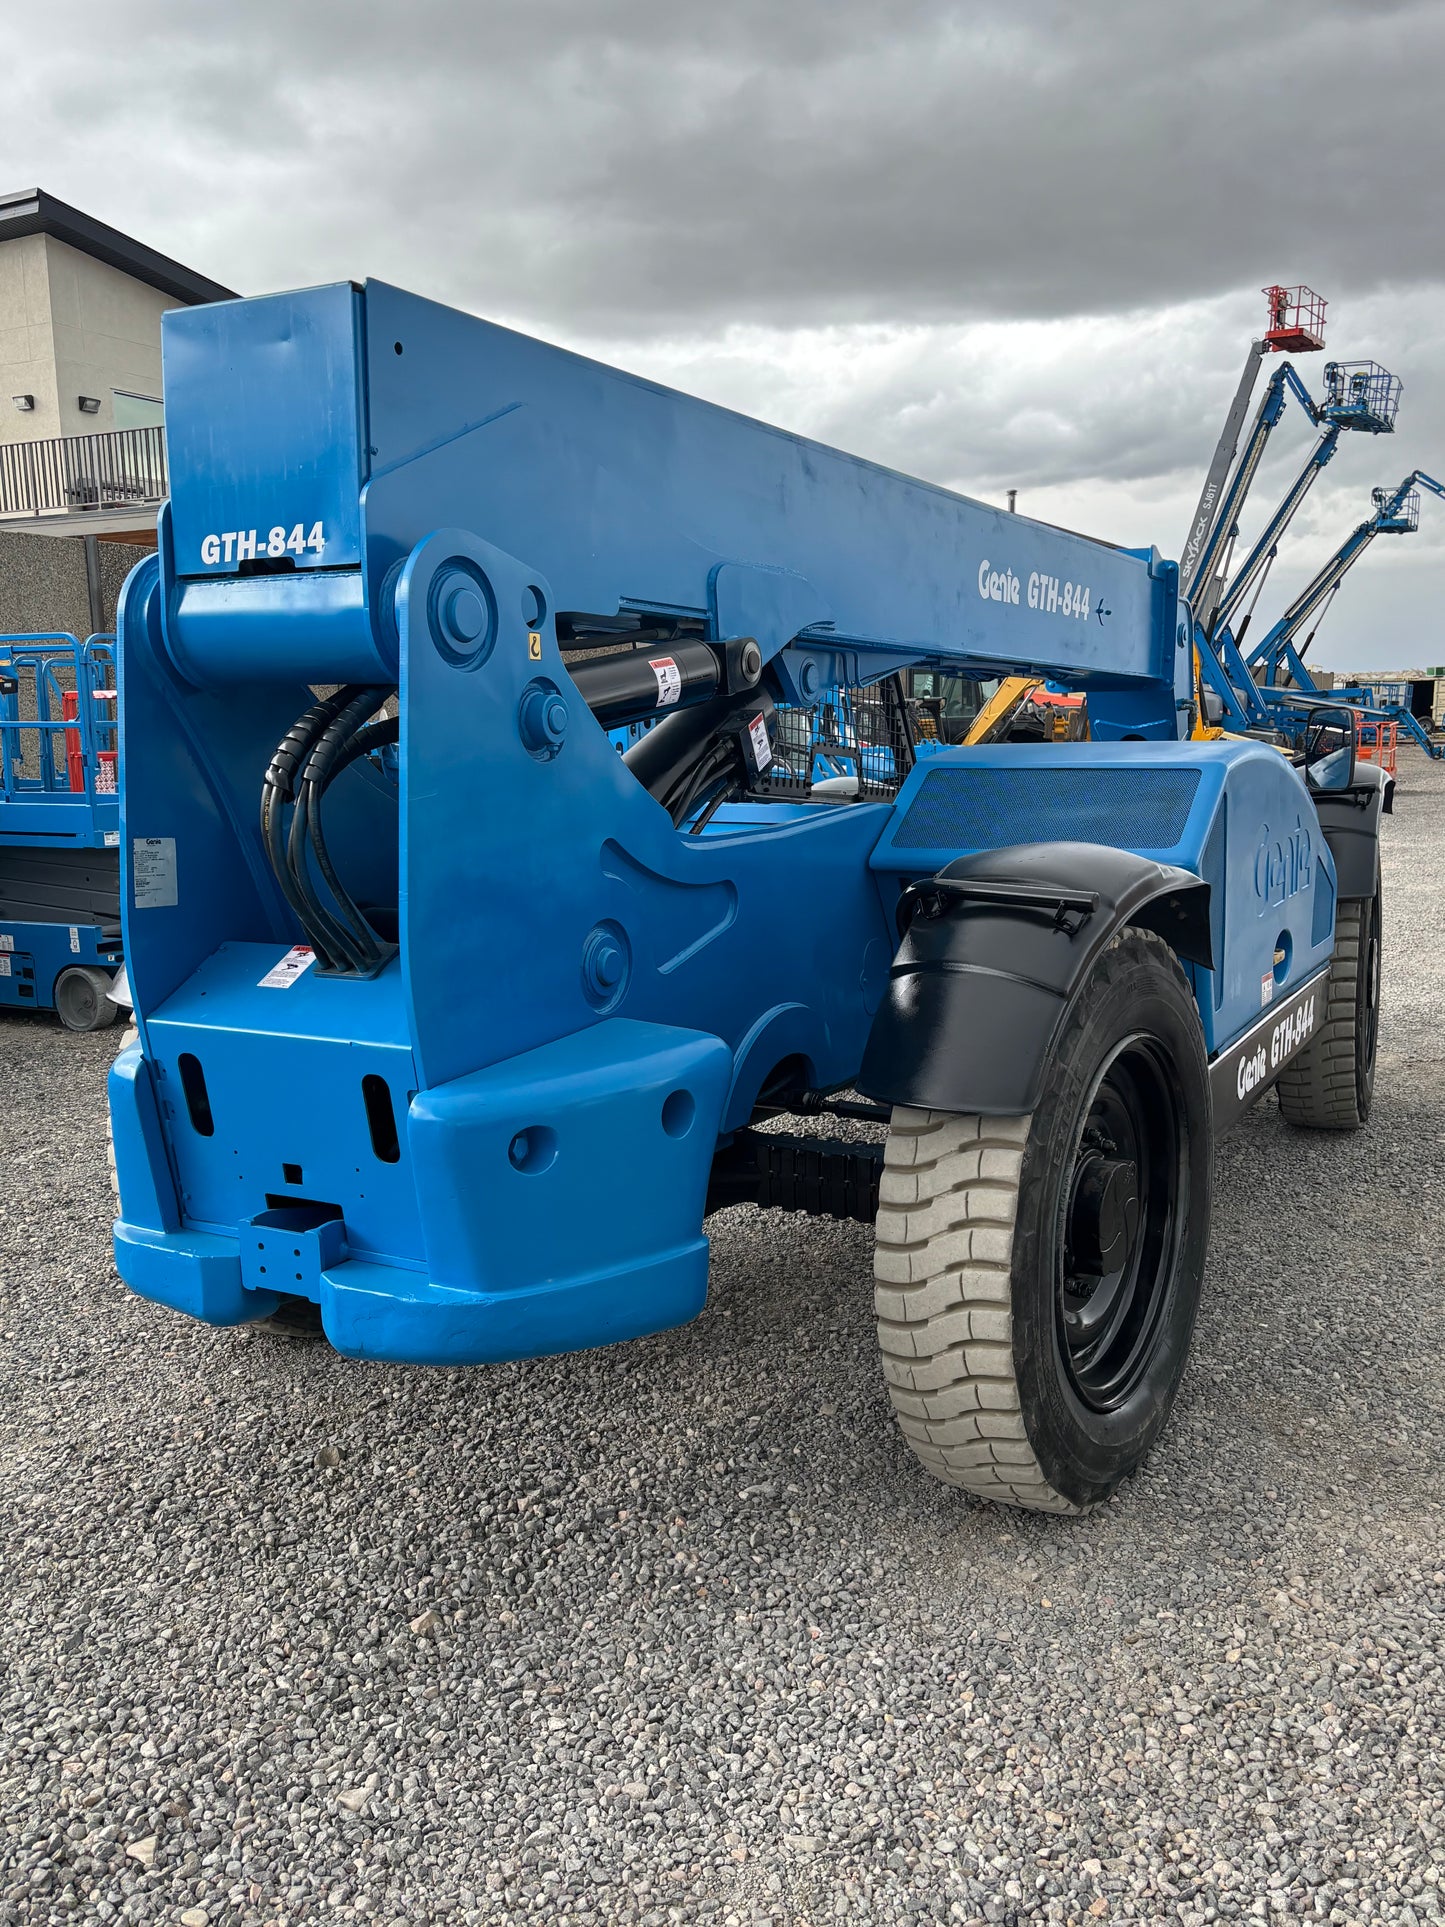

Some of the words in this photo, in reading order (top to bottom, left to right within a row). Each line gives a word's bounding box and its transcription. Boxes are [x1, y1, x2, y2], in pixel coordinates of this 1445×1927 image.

[201, 521, 325, 565] GTH-844
[1183, 516, 1208, 578] SKYJACK
[1203, 482, 1218, 510] SJ61T
[978, 559, 1020, 604] Genie
[1027, 571, 1090, 620] GTH-844
[1254, 814, 1311, 918] Genie
[1237, 1043, 1267, 1100] Genie
[1271, 995, 1315, 1068] GTH-844
